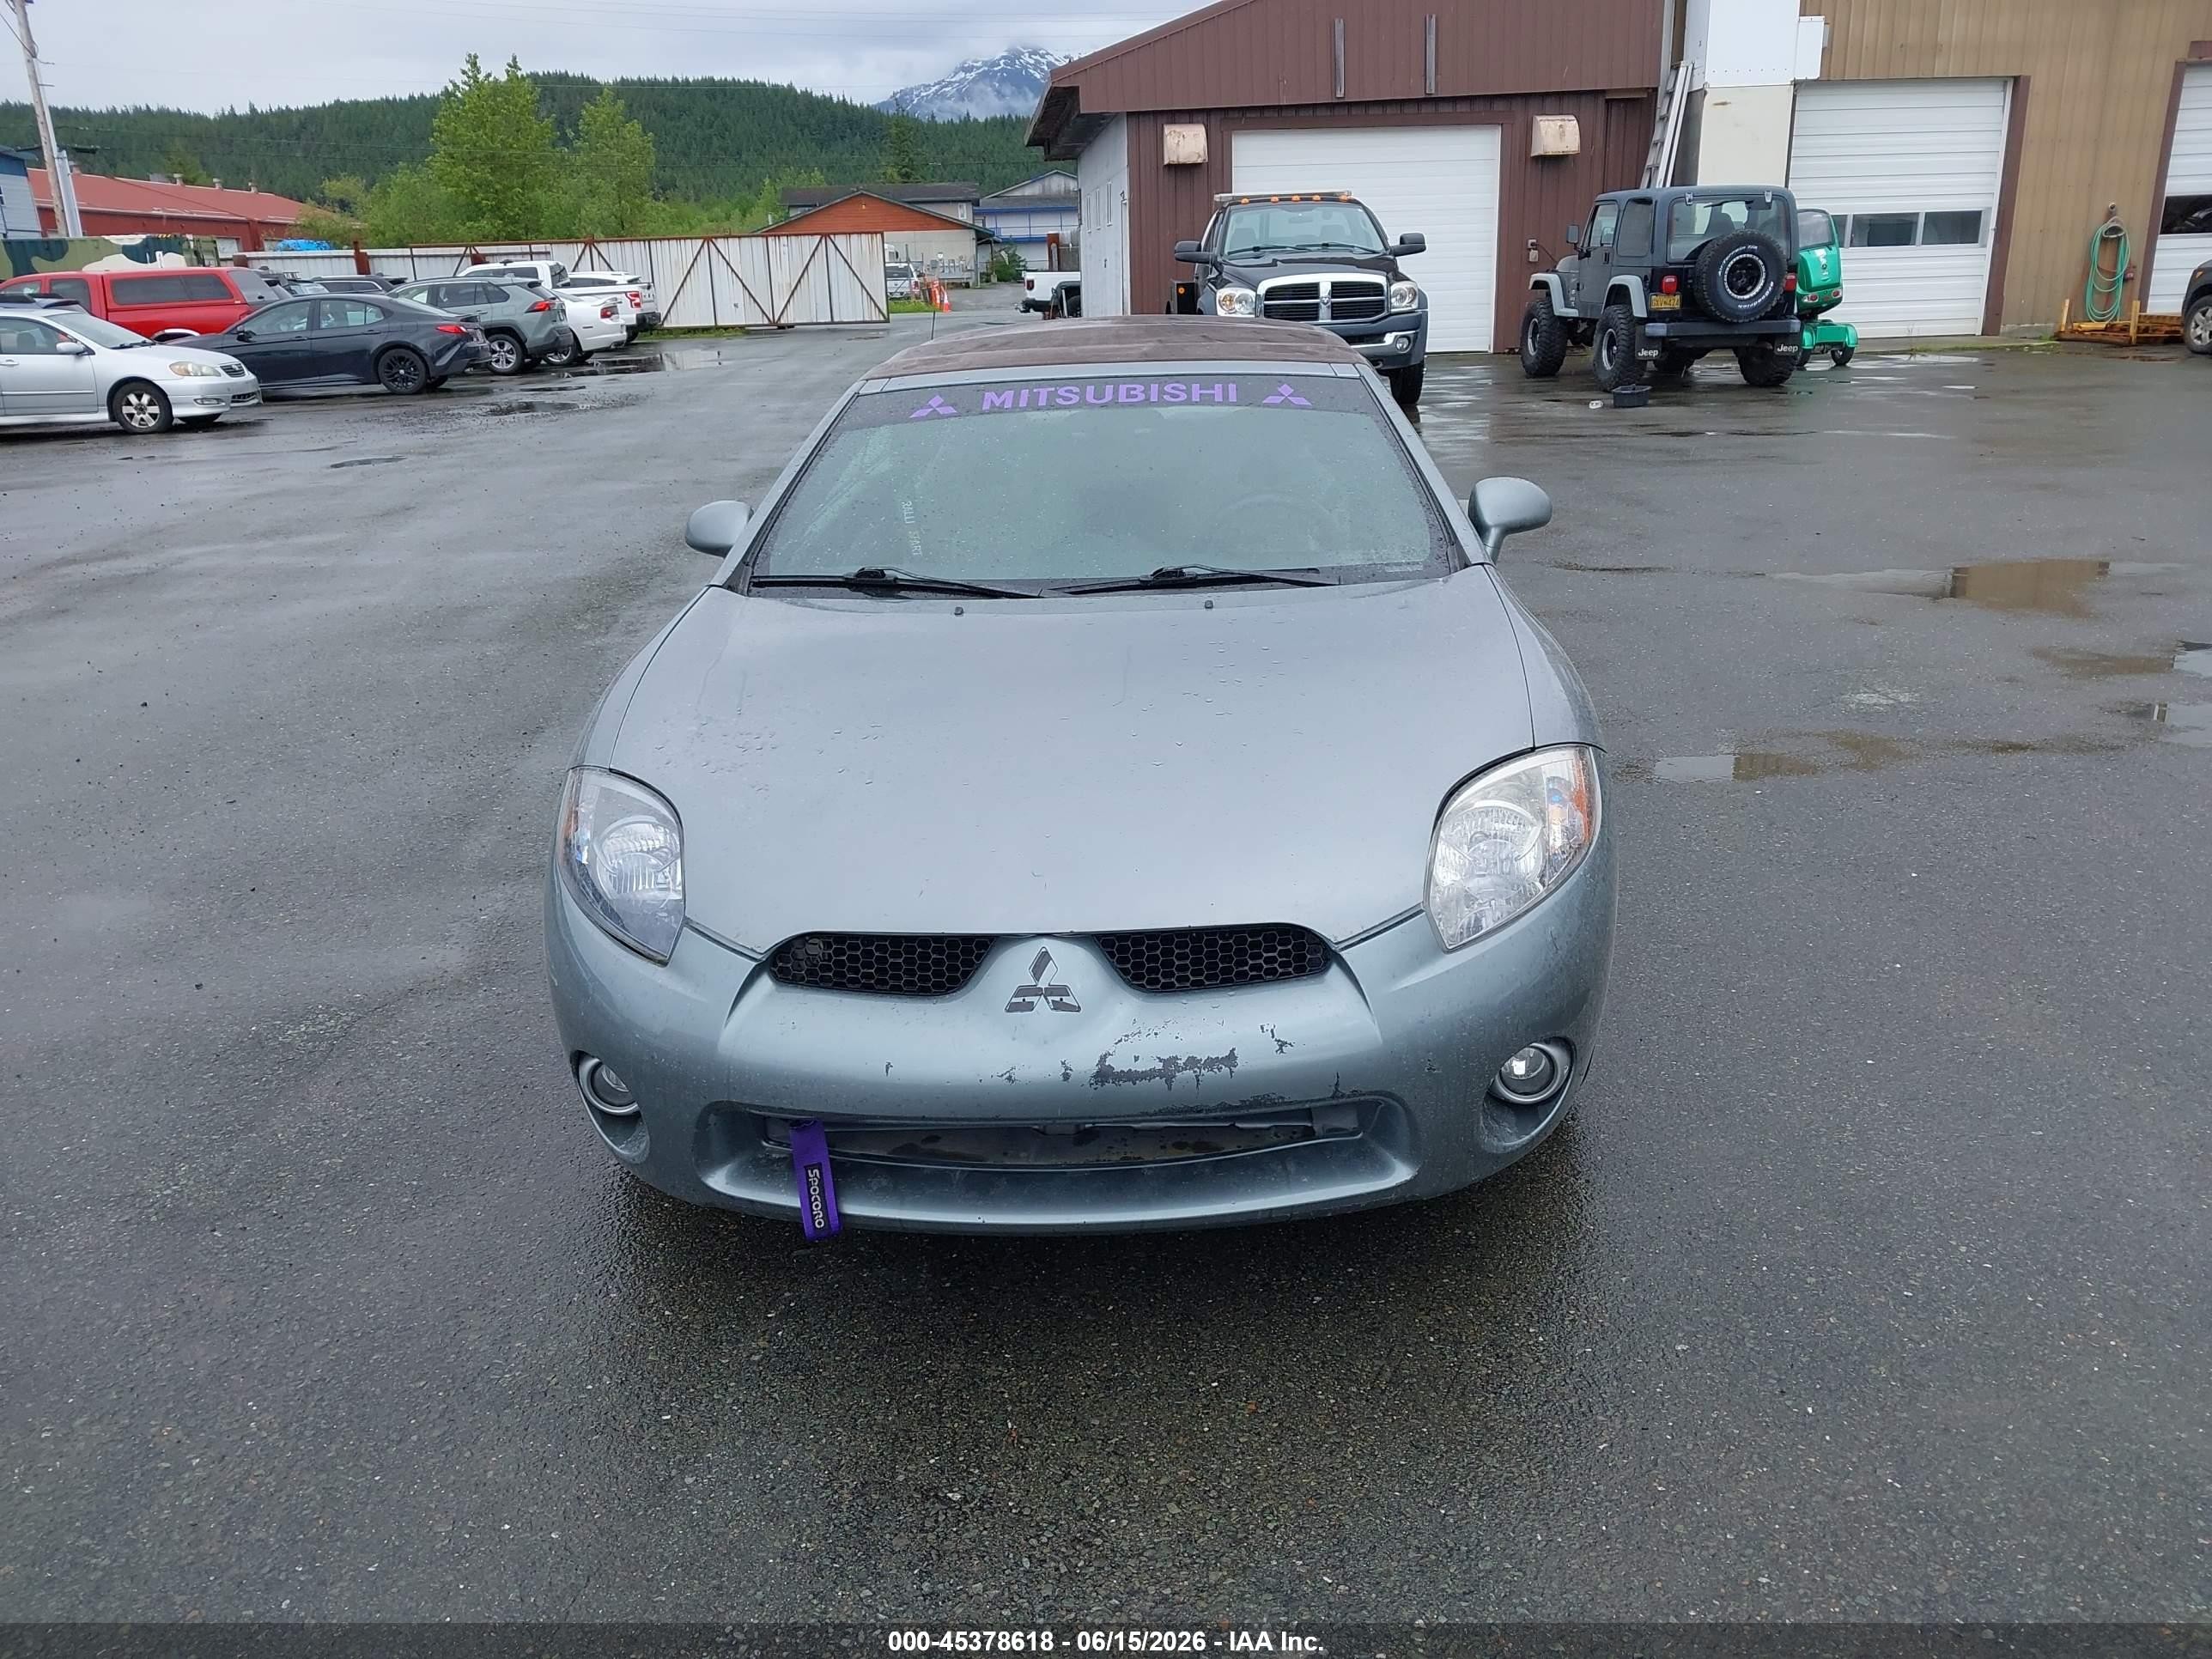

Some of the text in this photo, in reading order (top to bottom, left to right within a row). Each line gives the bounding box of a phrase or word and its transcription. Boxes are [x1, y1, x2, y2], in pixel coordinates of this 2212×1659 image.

[1777, 343, 1799, 352] Jeep
[1638, 348, 1659, 357] Jeep
[981, 382, 1238, 410] MITSUBISHI
